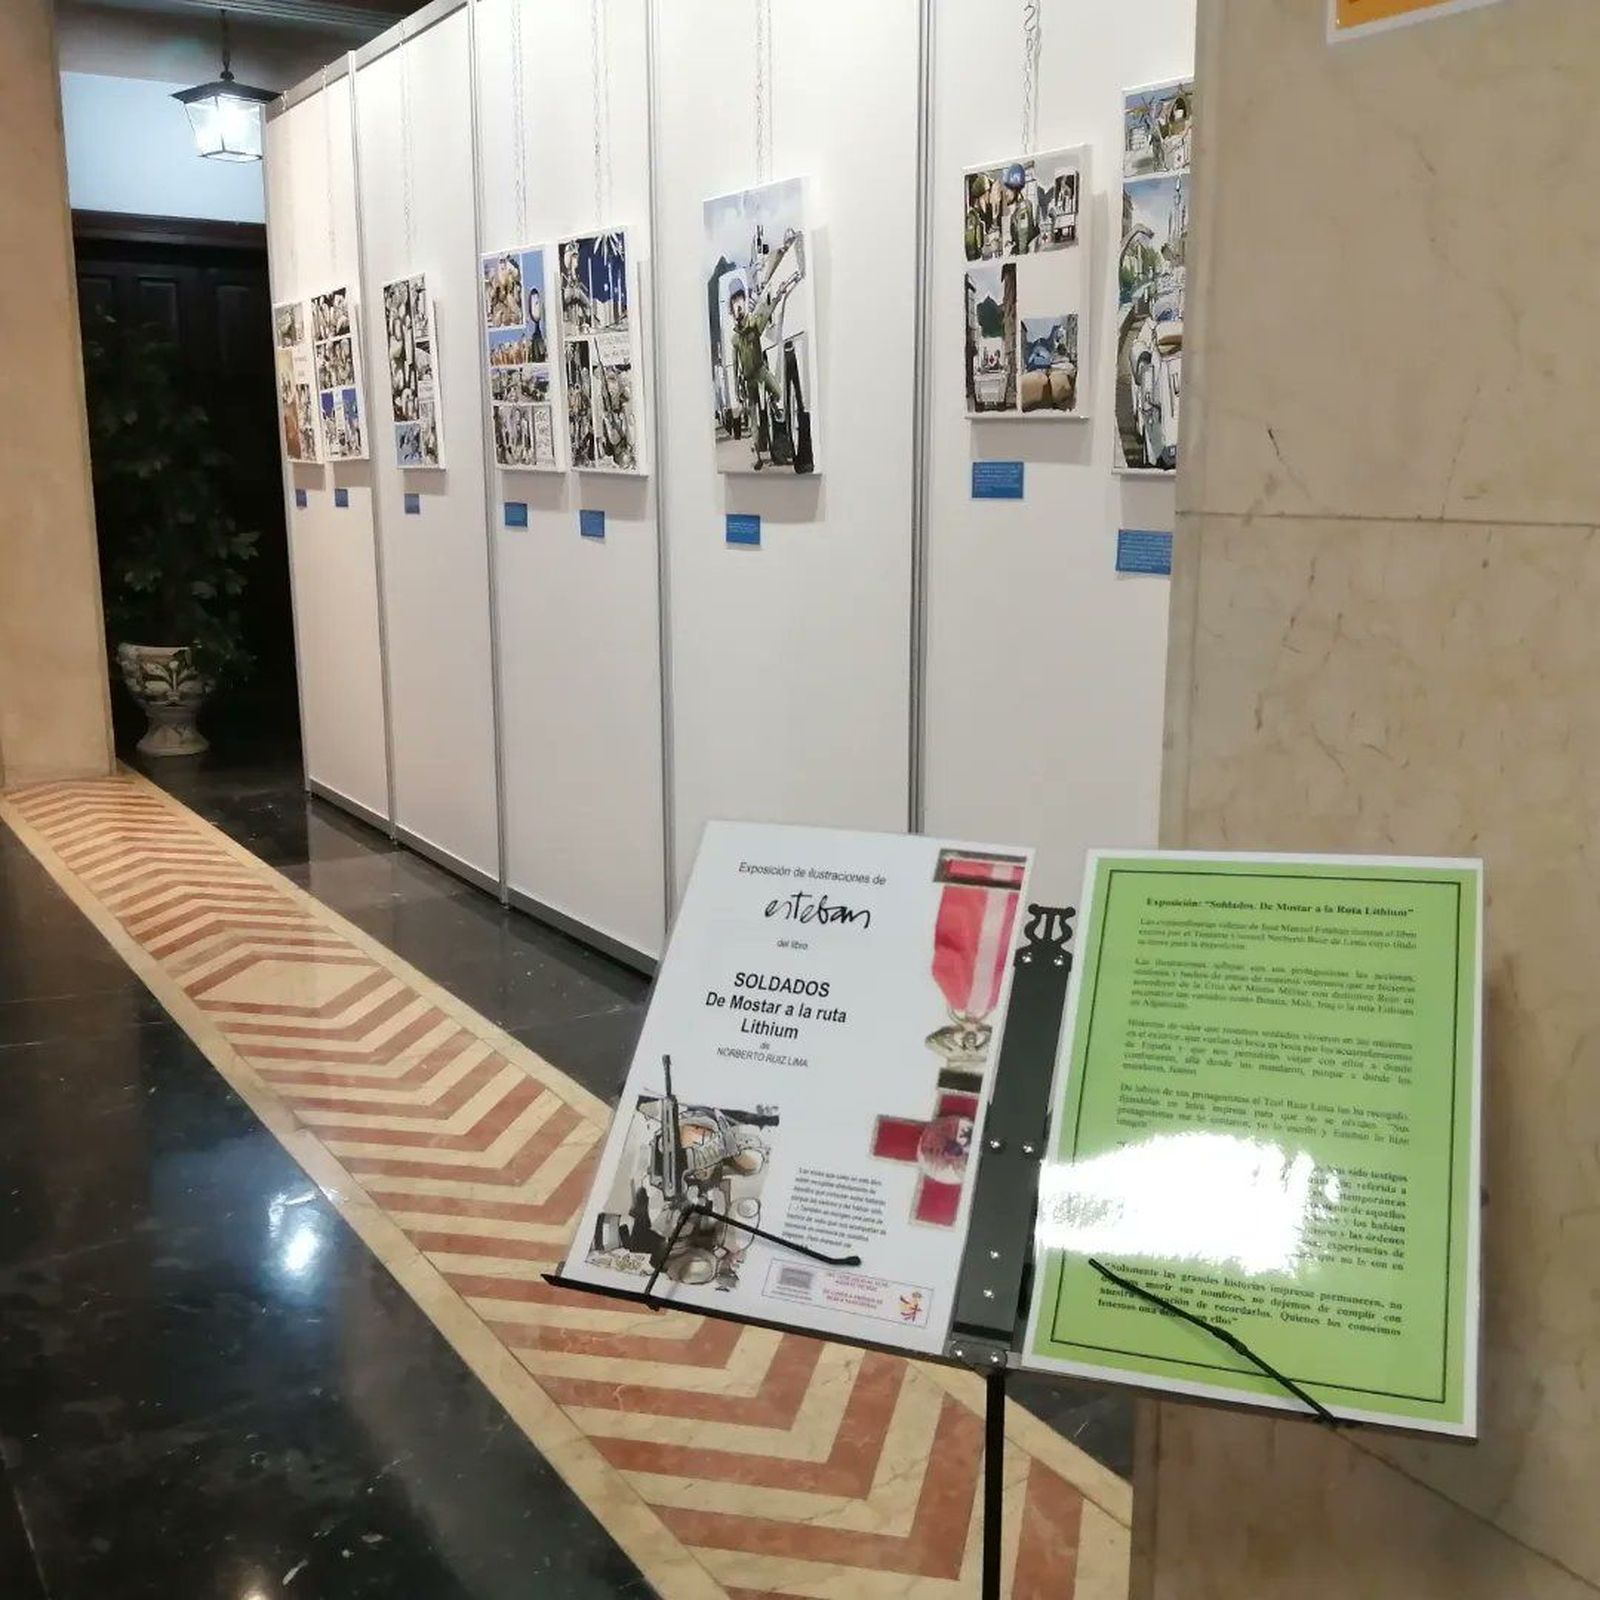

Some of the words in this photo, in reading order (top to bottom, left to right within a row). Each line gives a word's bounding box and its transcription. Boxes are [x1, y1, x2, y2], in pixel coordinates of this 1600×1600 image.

[738, 861, 790, 877] Exposición
[794, 868, 806, 878] de
[808, 867, 870, 884] ilustraciones
[872, 874, 887, 885] de
[764, 891, 871, 929] esteban
[1260, 902, 1274, 911] De
[1276, 903, 1312, 913] Mostar
[1324, 904, 1334, 914] la
[776, 938, 789, 948] del
[791, 939, 808, 950] libro
[734, 971, 831, 998] SOLDADOS
[705, 991, 726, 1007] De
[729, 994, 783, 1014] Mostar
[784, 1004, 795, 1016] a
[798, 1002, 812, 1019] la
[815, 1008, 847, 1023] ruta
[740, 1017, 799, 1039] Lithium
[716, 1047, 765, 1062] NORBERTO
[765, 1052, 787, 1065] RUIZ
[787, 1056, 809, 1068] LIMA
[1349, 1166, 1369, 1178] sido
[1371, 1170, 1408, 1183] testigos
[1356, 1181, 1397, 1194] referida
[1350, 1205, 1364, 1215] de
[1365, 1208, 1406, 1220] aquellos
[1392, 1248, 1405, 1259] de
[1162, 1269, 1177, 1280] las
[1180, 1273, 1219, 1286] grandes
[1224, 1277, 1267, 1292] historias
[1389, 1301, 1404, 1311] no
[1145, 1281, 1173, 1292] morir
[1251, 1296, 1266, 1305] no
[1318, 1303, 1331, 1314] de
[1336, 1308, 1376, 1322] cumplir
[1383, 1314, 1403, 1324] con
[1196, 1300, 1208, 1310] de
[1280, 1311, 1321, 1326] Quienes
[1327, 1317, 1342, 1328] los
[1347, 1322, 1402, 1337] conocimos
